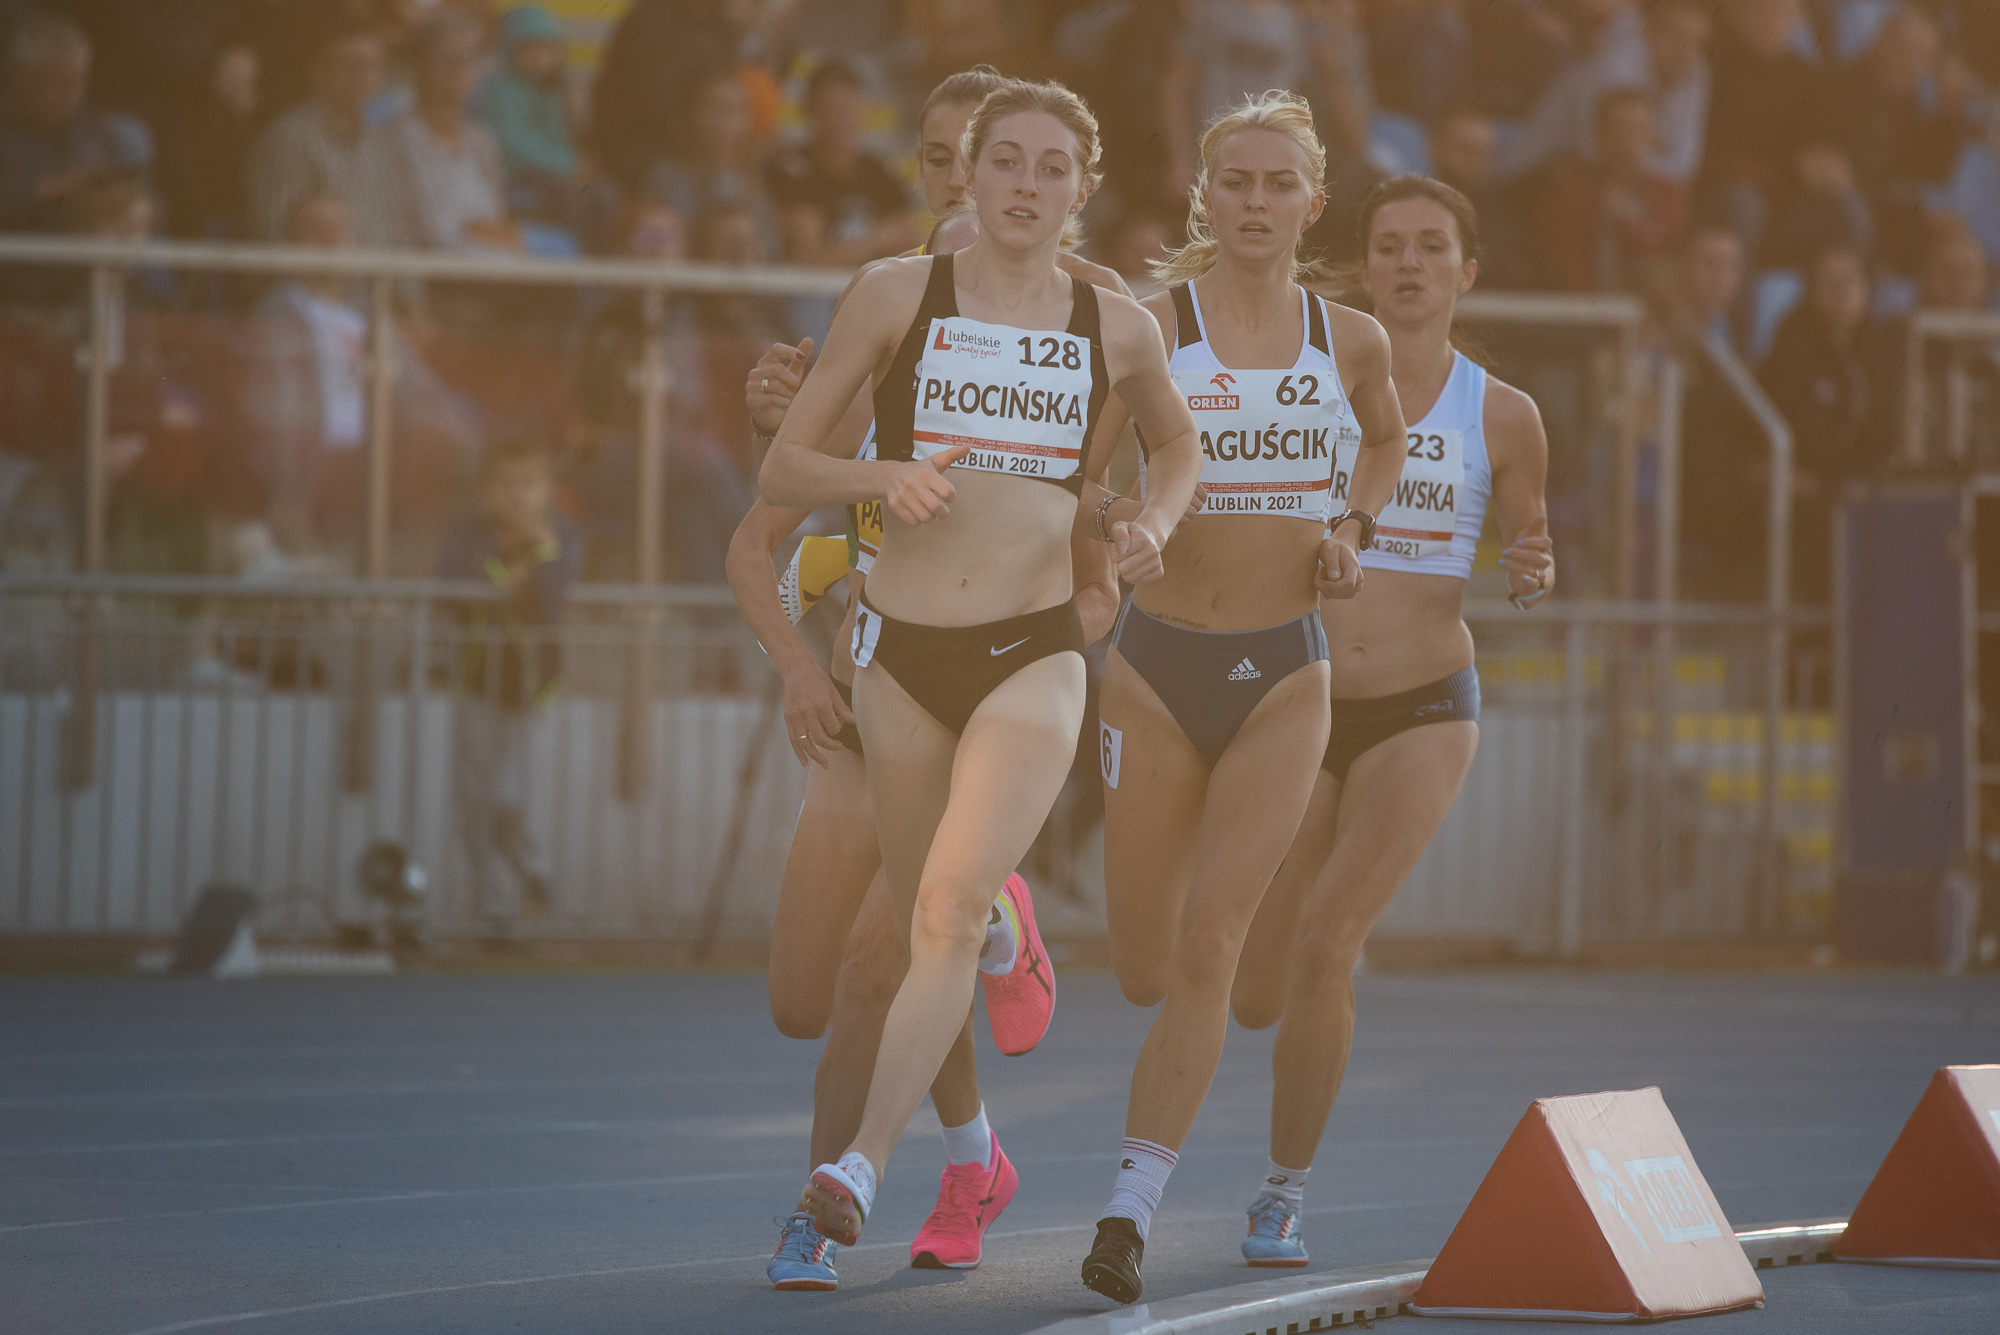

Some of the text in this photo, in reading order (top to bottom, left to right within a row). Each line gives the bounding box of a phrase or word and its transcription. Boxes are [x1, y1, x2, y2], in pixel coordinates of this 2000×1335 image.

[1017, 336, 1082, 370] 128
[923, 378, 1083, 427] PŁOCIŃSKA
[1190, 397, 1237, 409] ORLEN
[1276, 374, 1320, 406] 62
[1200, 422, 1329, 462] AGUŚCIK
[1407, 433, 1445, 462] 23
[952, 452, 1046, 475] UBLIN 2021
[1207, 495, 1302, 511] LUBLIN 2021
[1385, 540, 1419, 556] 2021
[1227, 670, 1261, 680] adidas
[1102, 728, 1112, 779] 6
[1636, 1168, 1713, 1232] ORLEN
